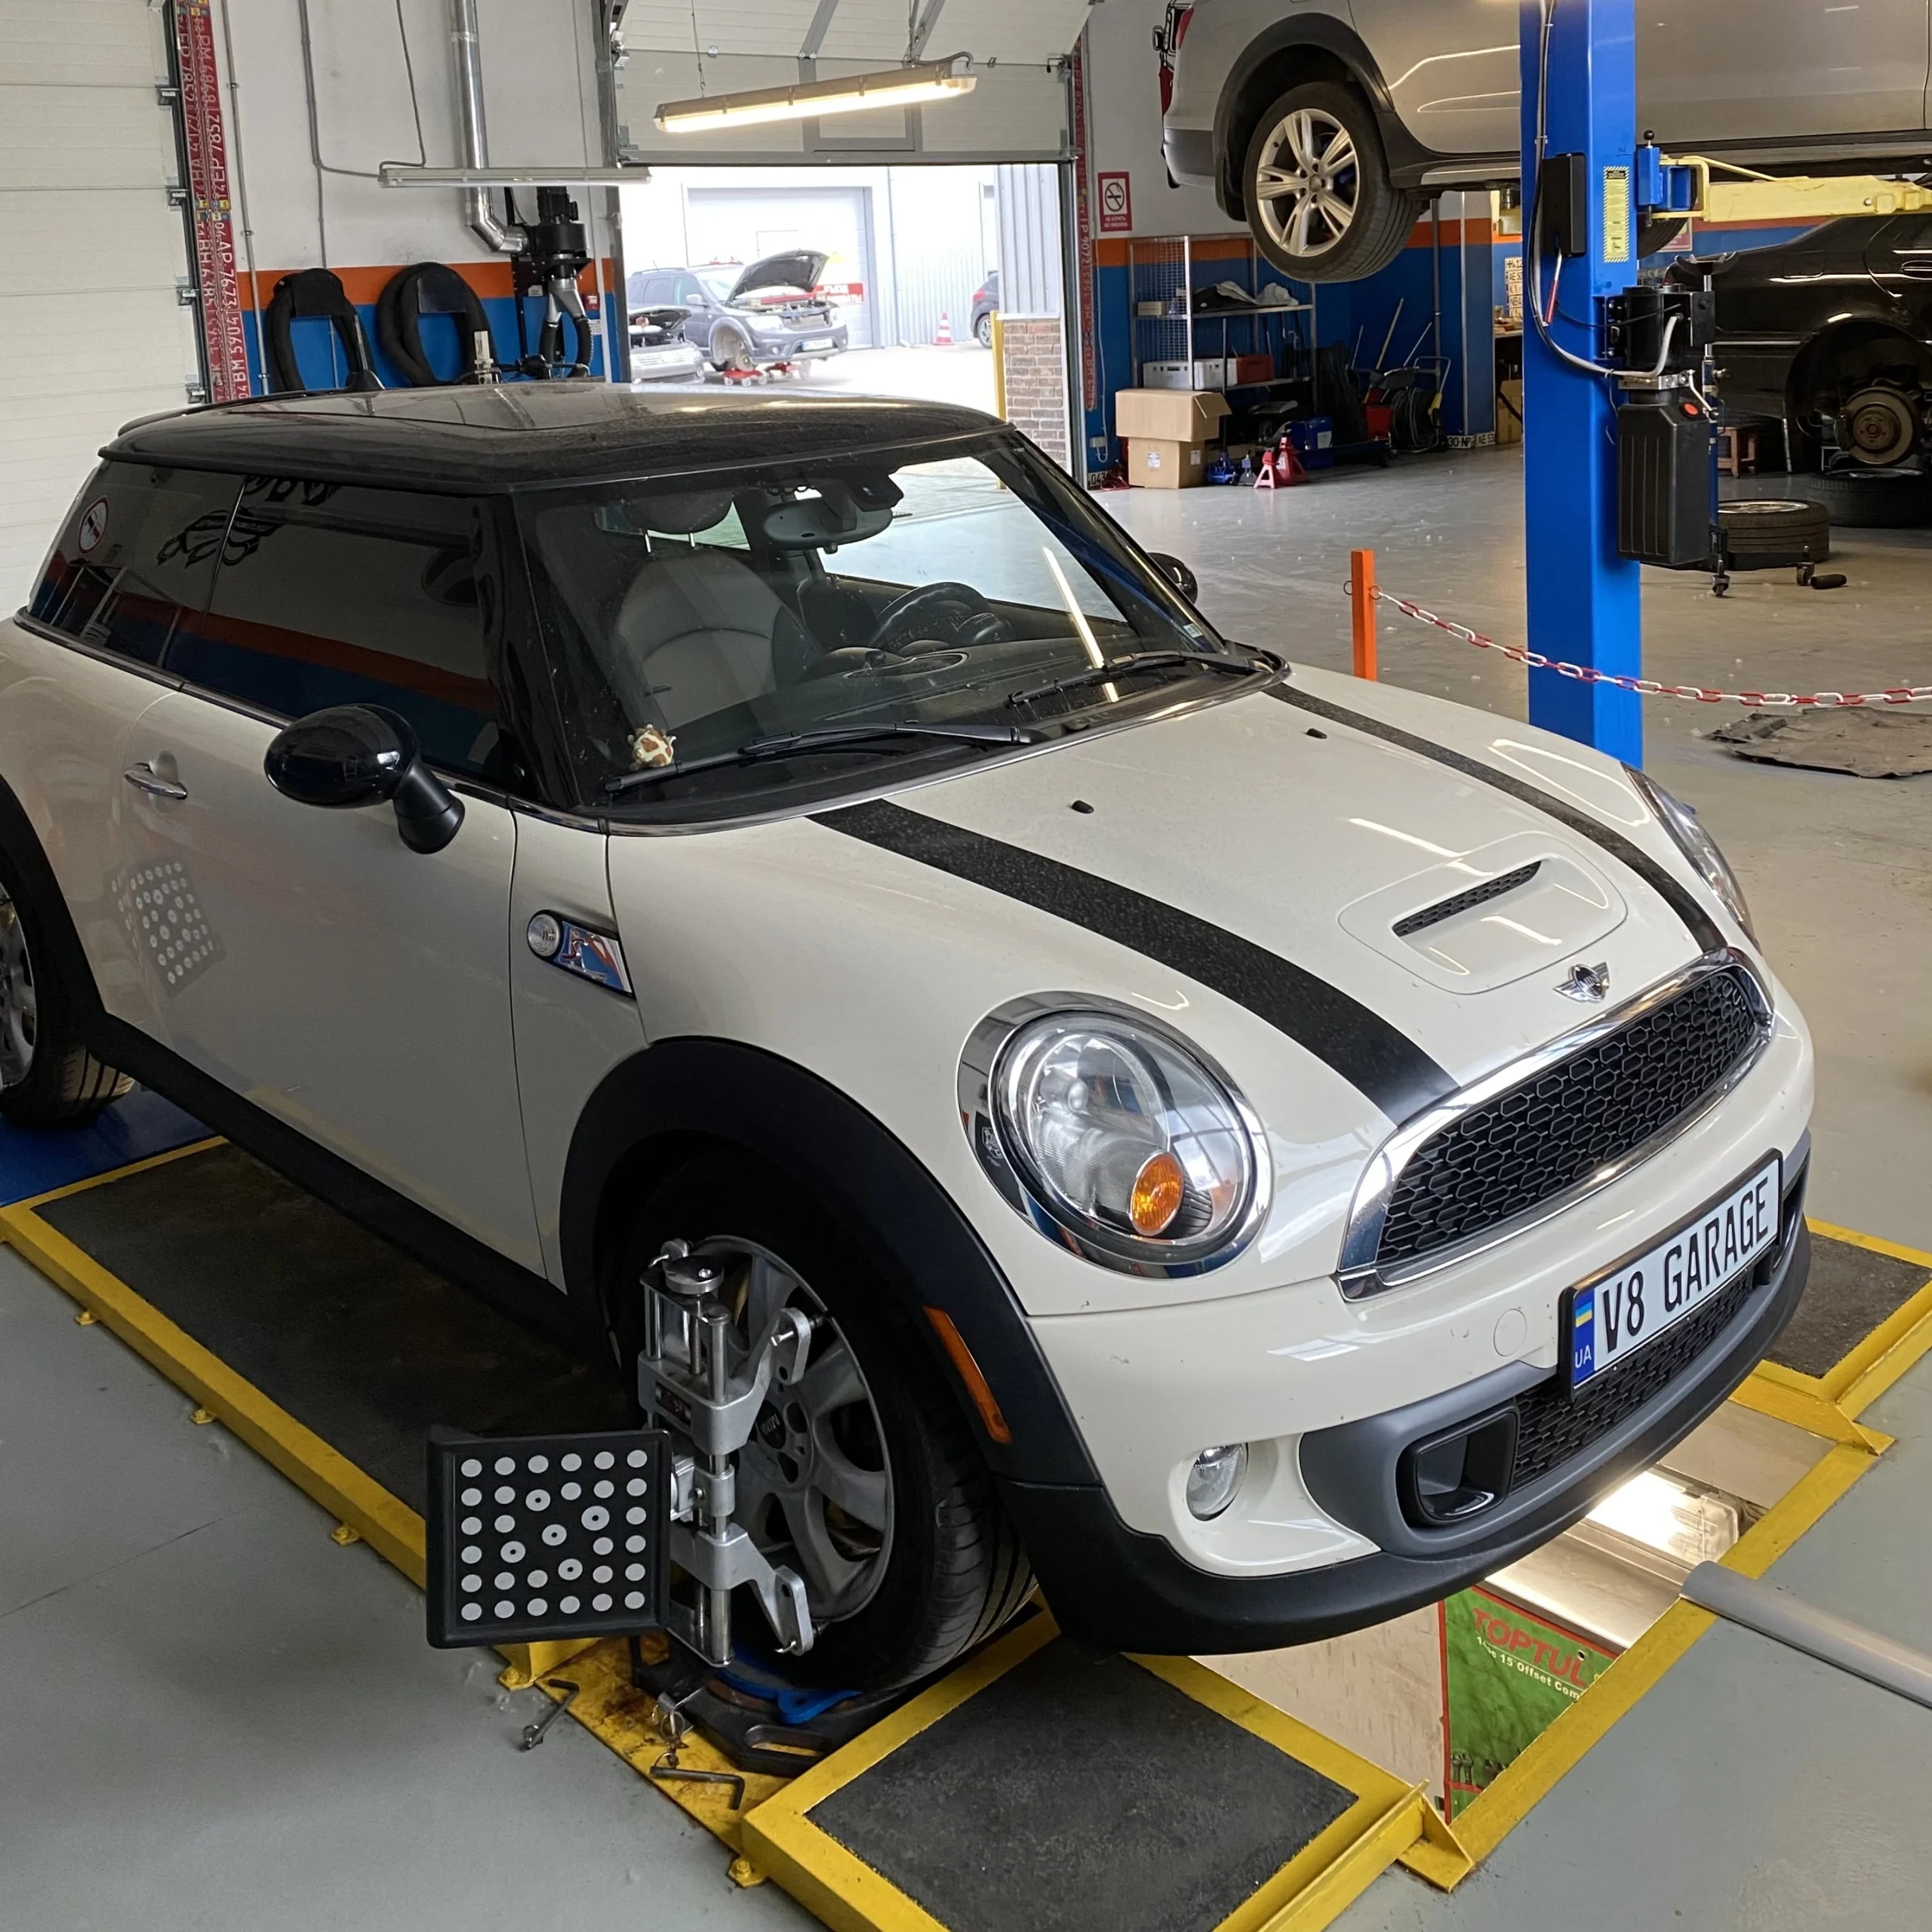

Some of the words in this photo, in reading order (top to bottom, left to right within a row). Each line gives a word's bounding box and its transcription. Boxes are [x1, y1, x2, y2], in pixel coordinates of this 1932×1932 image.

[199, 65, 217, 103] 6868
[208, 115, 222, 151] 7852
[220, 269, 237, 306] 7673
[226, 317, 243, 354] 5904
[232, 359, 247, 382] BM
[1603, 1271, 1644, 1353] V8
[1664, 1176, 1768, 1312] GARAGE
[1575, 1345, 1592, 1368] UA
[1472, 1607, 1589, 1688] TOPTUL
[1517, 1662, 1552, 1687] Offset
